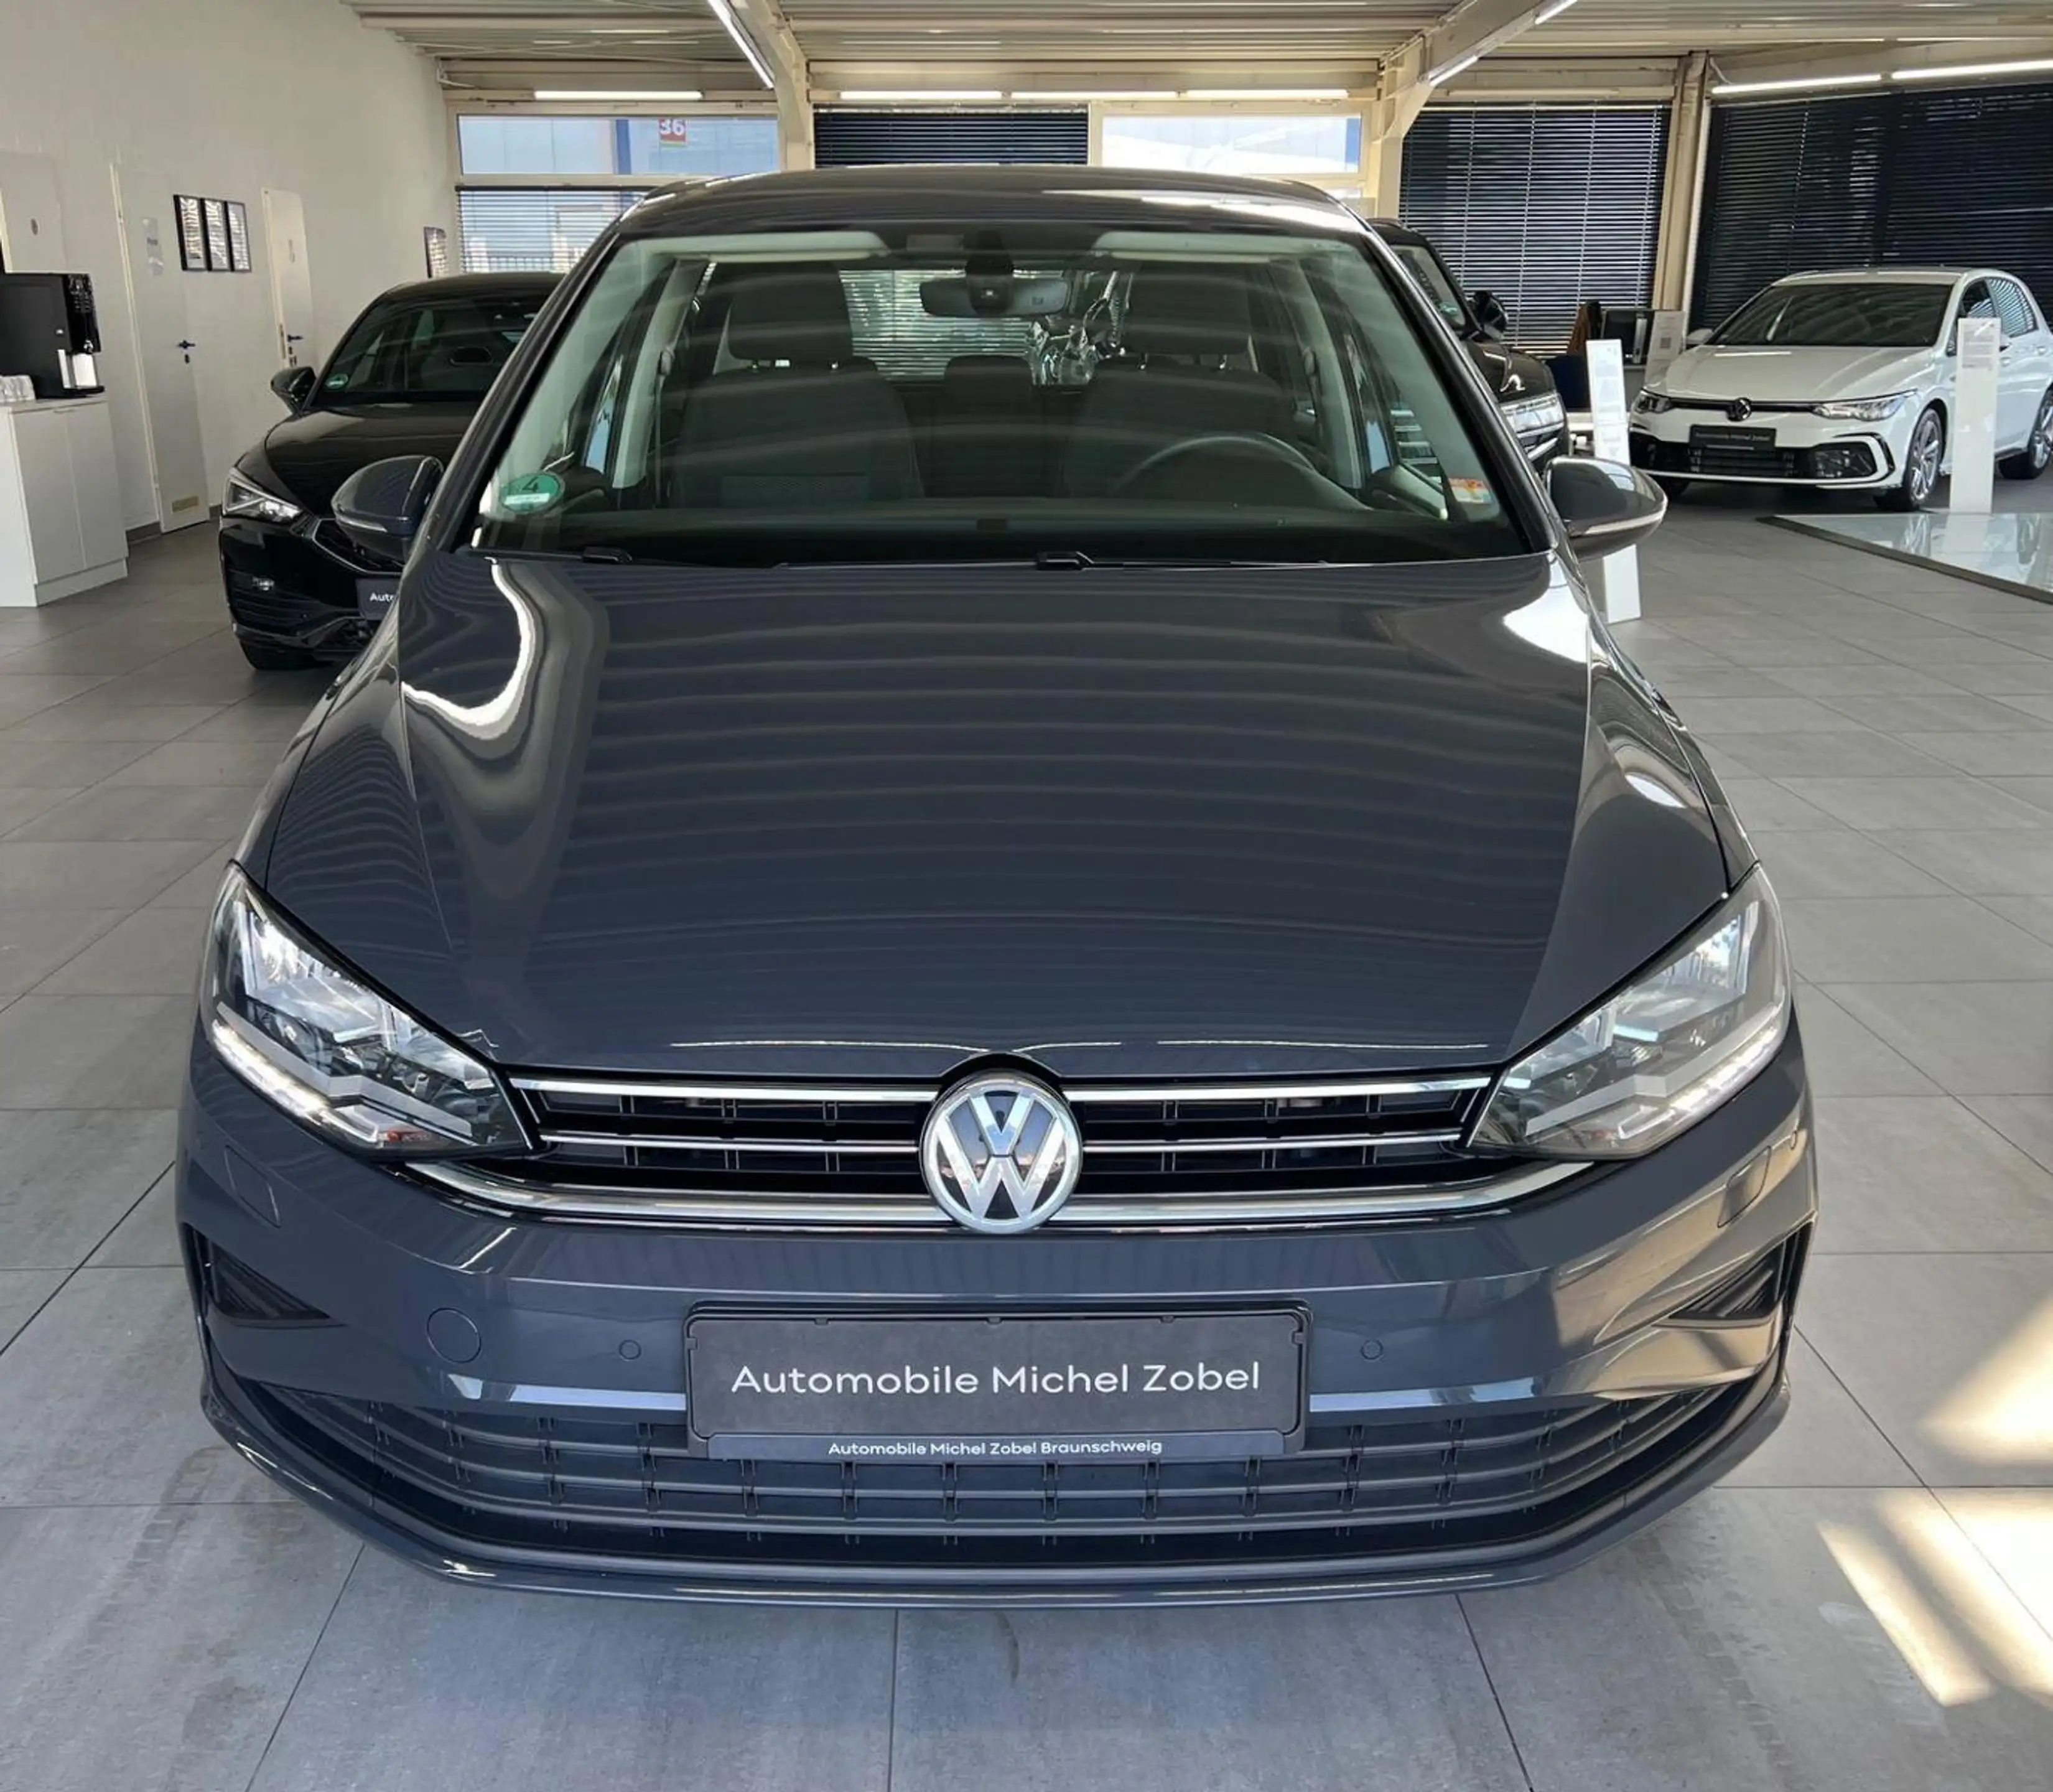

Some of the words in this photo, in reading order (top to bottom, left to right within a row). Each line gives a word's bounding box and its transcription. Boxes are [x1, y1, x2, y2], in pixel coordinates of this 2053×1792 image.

[659, 117, 685, 136] 36
[731, 1365, 979, 1394] Automobile
[992, 1363, 1129, 1394] Michel
[1142, 1361, 1259, 1392] Zobel
[828, 1442, 926, 1455] Automobile
[931, 1442, 985, 1455] Michel
[990, 1441, 1037, 1455] Zobel
[1041, 1439, 1163, 1455] Braunschweig
